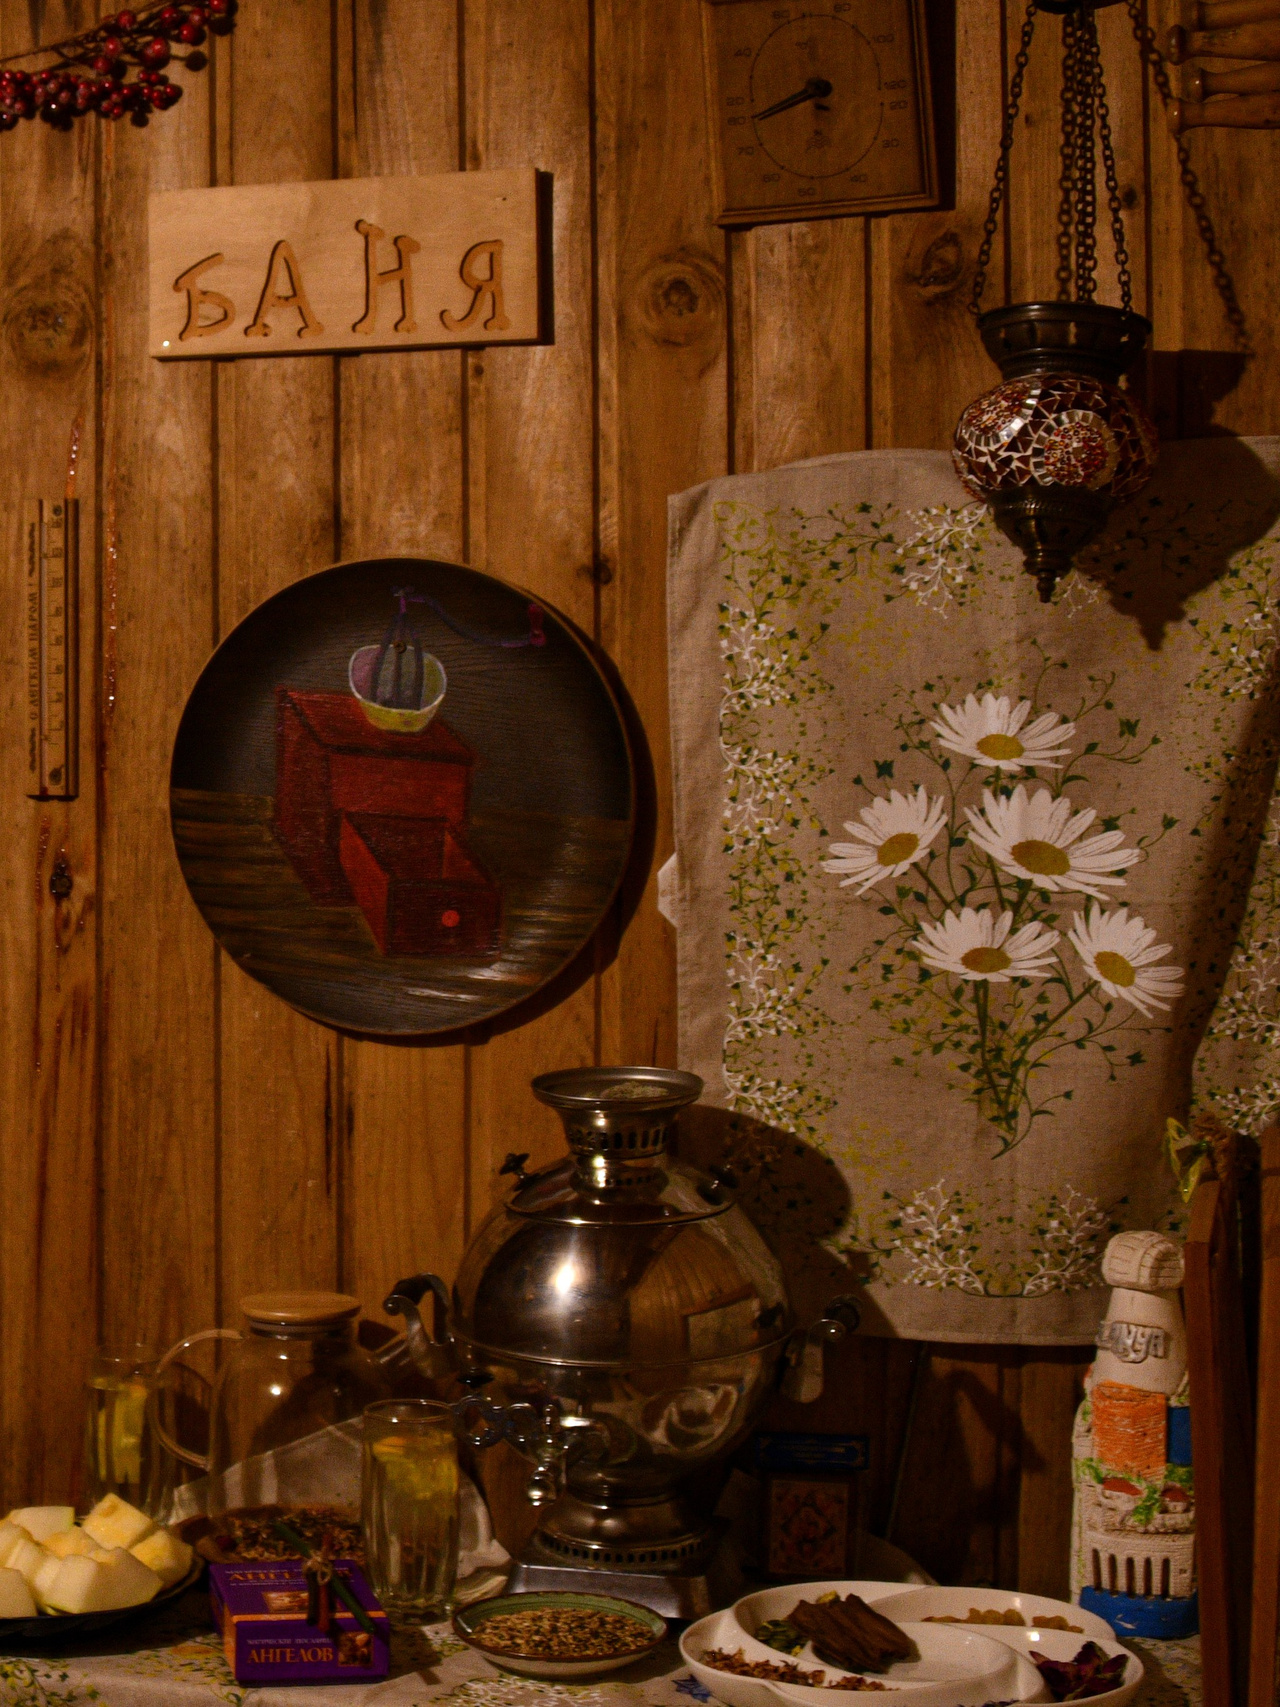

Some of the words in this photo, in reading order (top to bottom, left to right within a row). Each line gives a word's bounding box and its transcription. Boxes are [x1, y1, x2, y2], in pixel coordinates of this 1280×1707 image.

[734, 48, 751, 57] 40
[890, 100, 908, 110] 20
[882, 138, 900, 148] 30
[737, 146, 754, 155] 70
[173, 219, 510, 341] БАНЯ
[247, 1647, 334, 1664] АНГЕЛОВ
